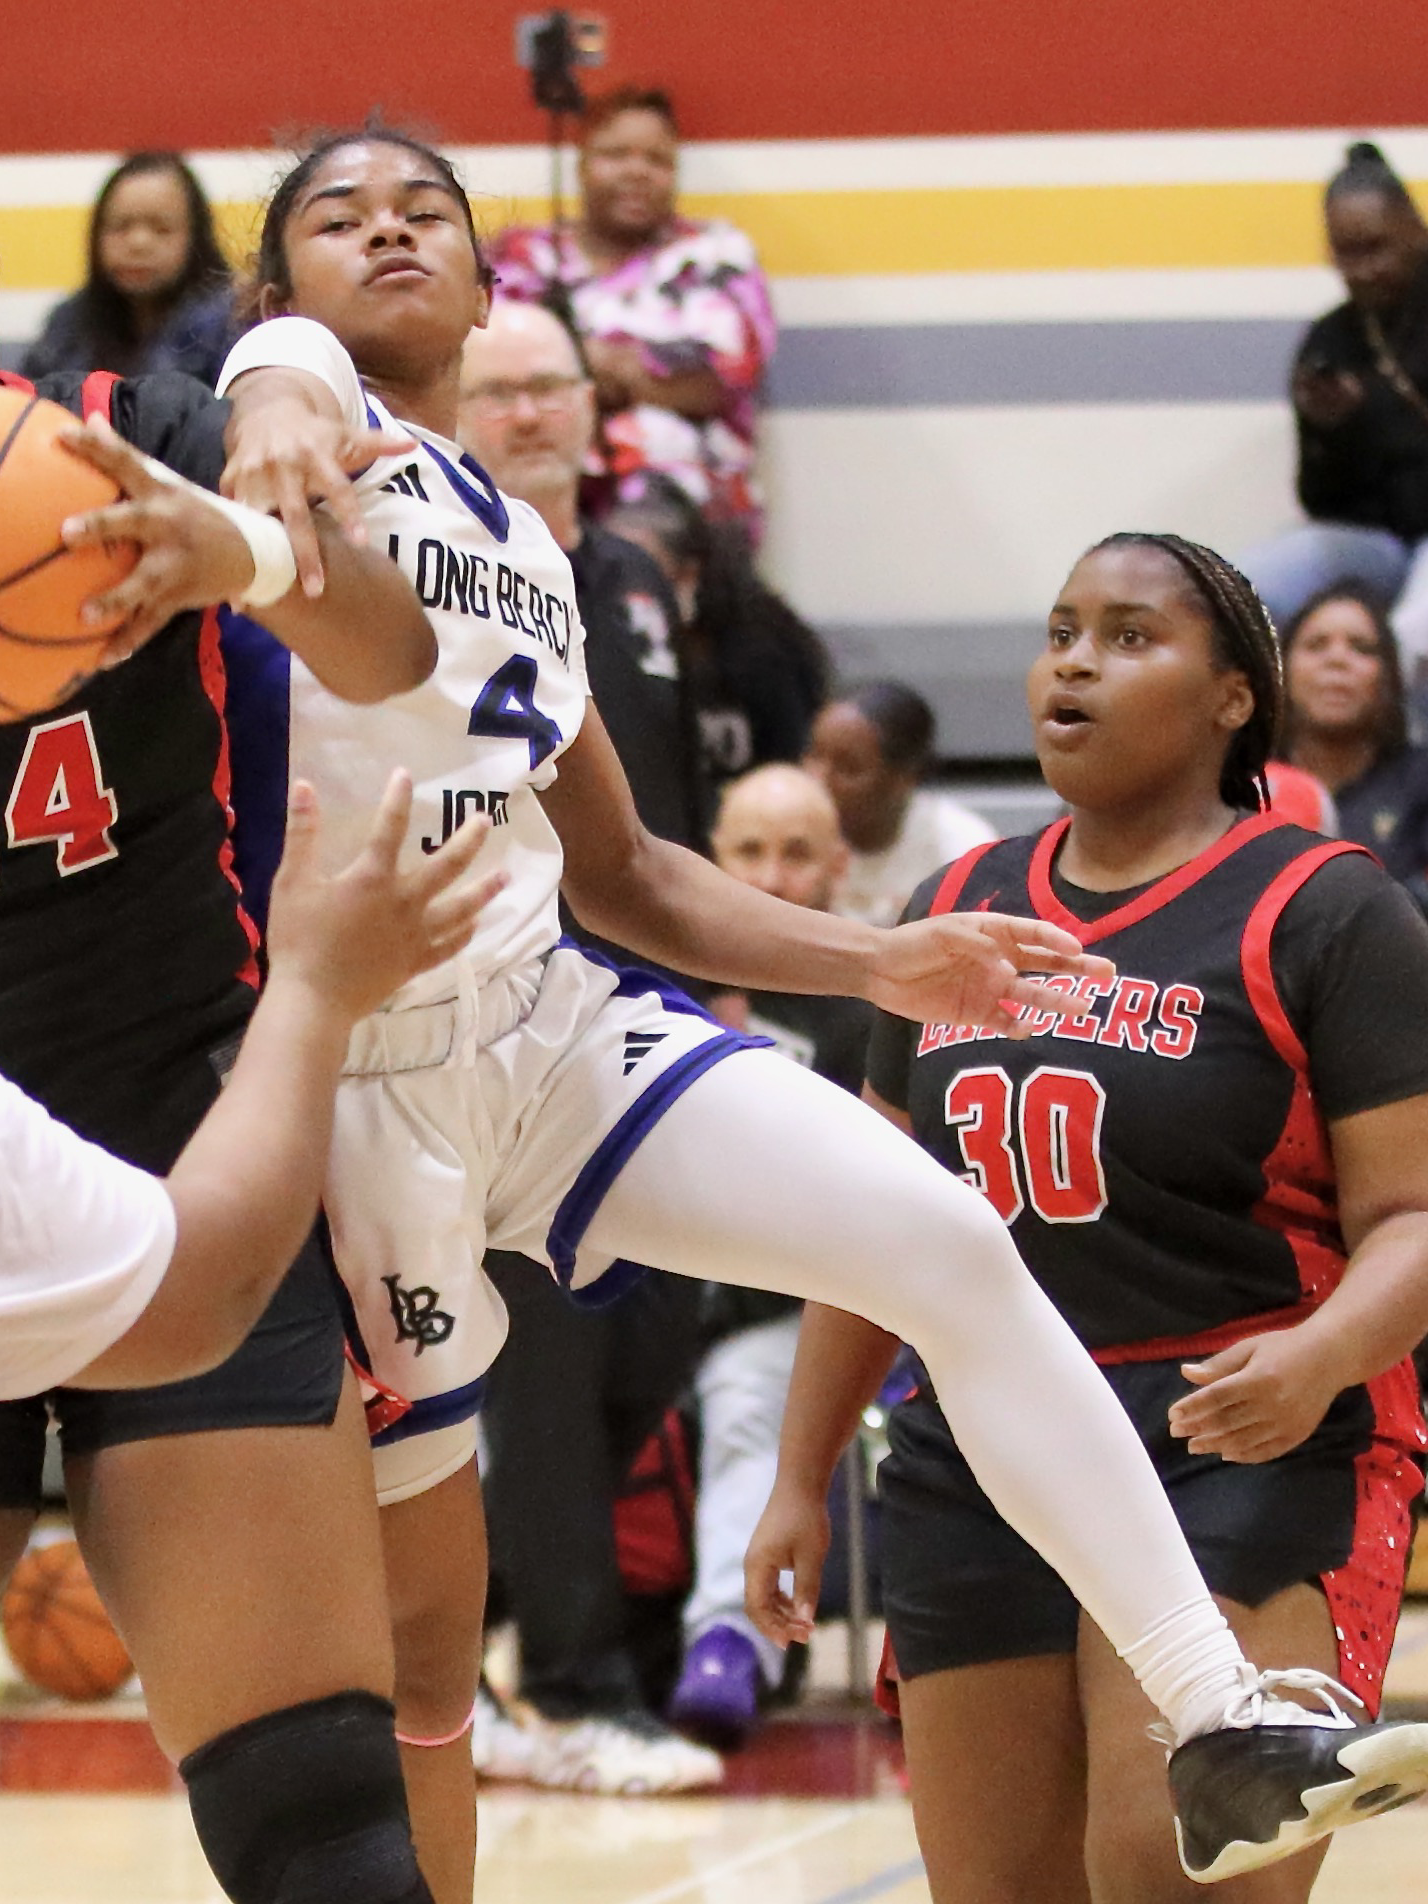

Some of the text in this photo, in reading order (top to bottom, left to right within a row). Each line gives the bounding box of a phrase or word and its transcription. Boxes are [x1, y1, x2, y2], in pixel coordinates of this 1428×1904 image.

[466, 653, 563, 771] 4
[917, 974, 1204, 1060] LCERS
[945, 1065, 1108, 1226] 30
